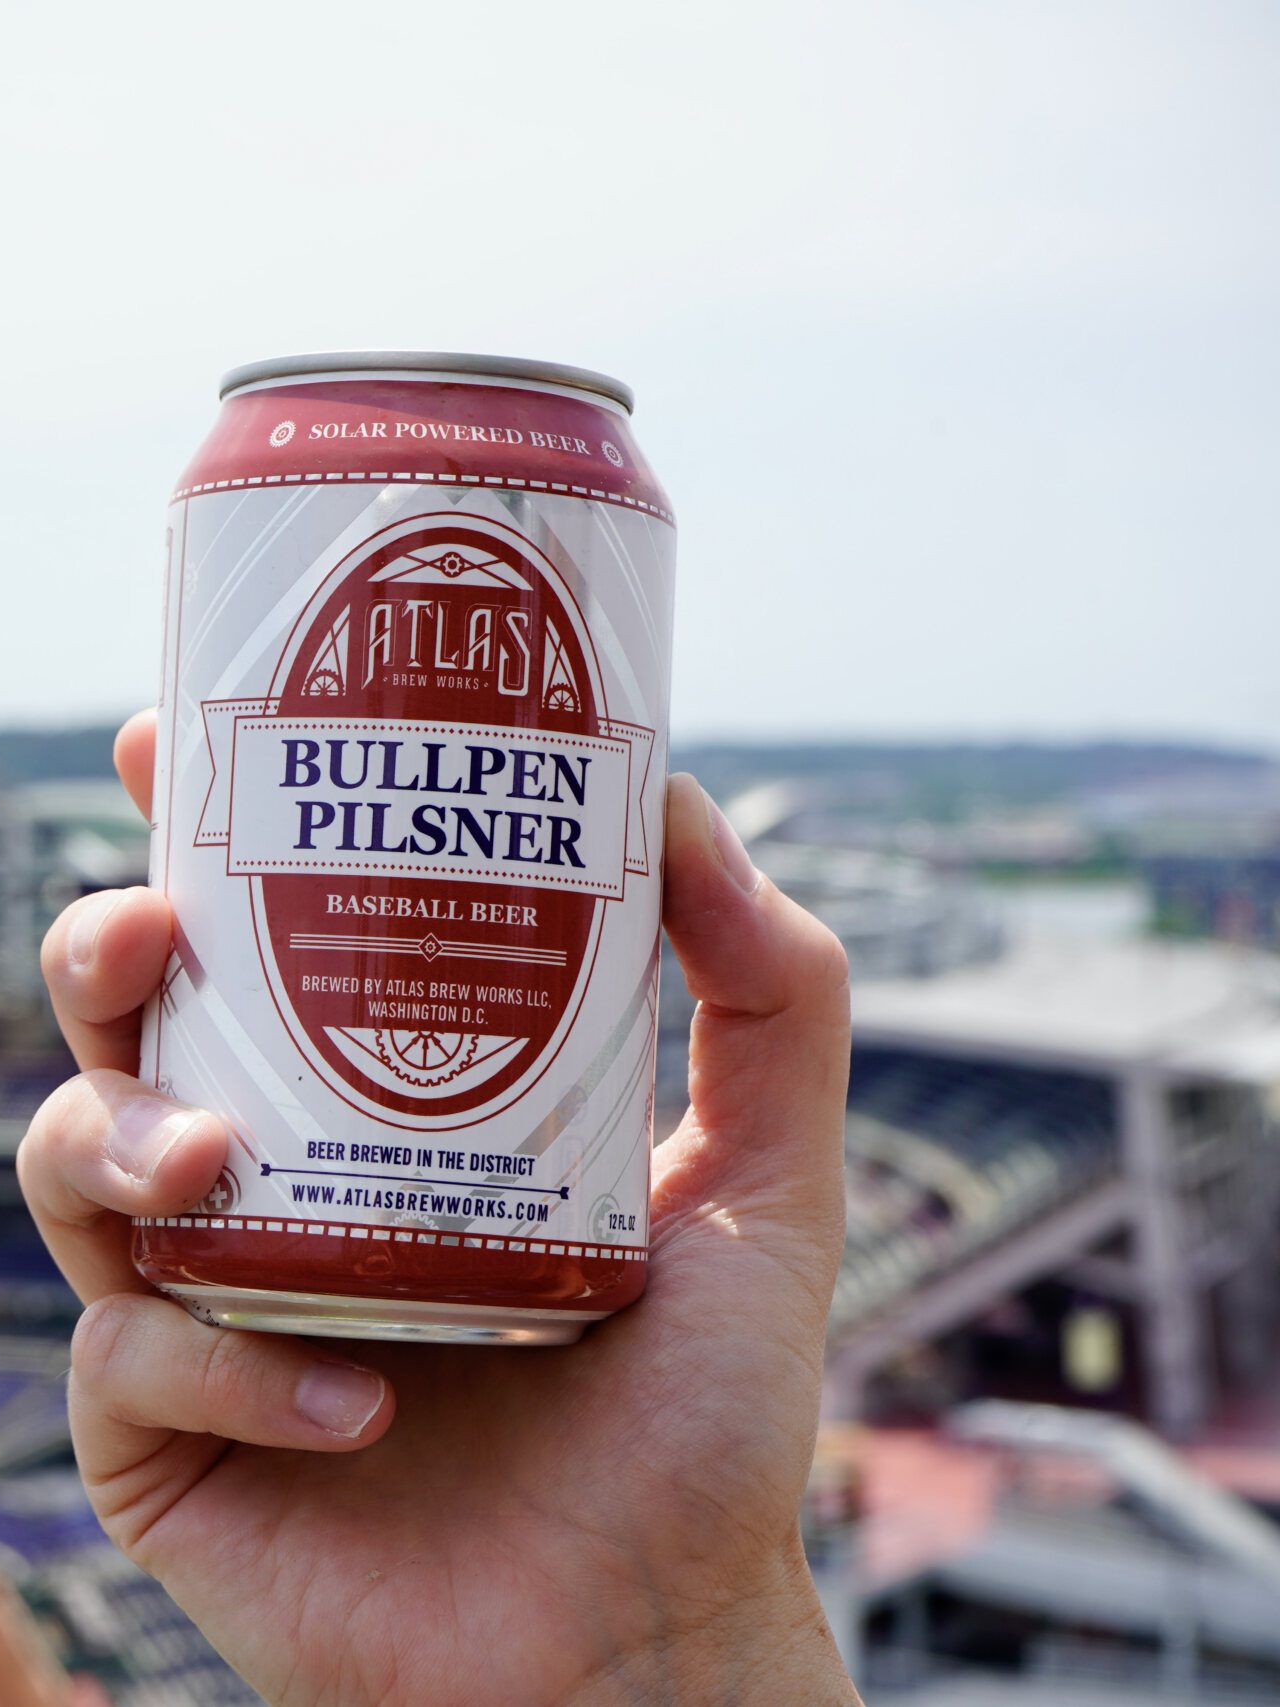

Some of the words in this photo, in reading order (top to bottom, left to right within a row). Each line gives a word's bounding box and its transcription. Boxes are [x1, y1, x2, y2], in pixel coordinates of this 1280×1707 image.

[308, 422, 387, 440] SOLAR
[395, 422, 523, 445] POWERED
[529, 431, 591, 455] BEER
[361, 598, 532, 697] ATLAS
[392, 673, 428, 687] BREW
[436, 676, 479, 690] WORKS
[279, 739, 592, 806] BULLPEN
[293, 801, 586, 868] PILSNER
[326, 894, 464, 921] BASEBALL
[470, 902, 538, 927] BEER
[302, 975, 359, 994] BREWED
[364, 978, 381, 995] BY
[386, 979, 425, 998] ATLAS
[429, 982, 470, 1001] BREW
[476, 985, 523, 1005] WORKS
[527, 990, 552, 1009] LLC,
[368, 1001, 457, 1022] WASHINGTON
[462, 1008, 489, 1025] D.C.
[307, 1141, 345, 1161] BEER
[350, 1144, 412, 1166] BREWED
[417, 1149, 432, 1167] IN
[437, 1150, 465, 1170] THE
[470, 1153, 535, 1176] DISTRICT
[292, 1184, 549, 1222] WWW.ATLASBREWWORKS.COM
[609, 1213, 618, 1230] 12
